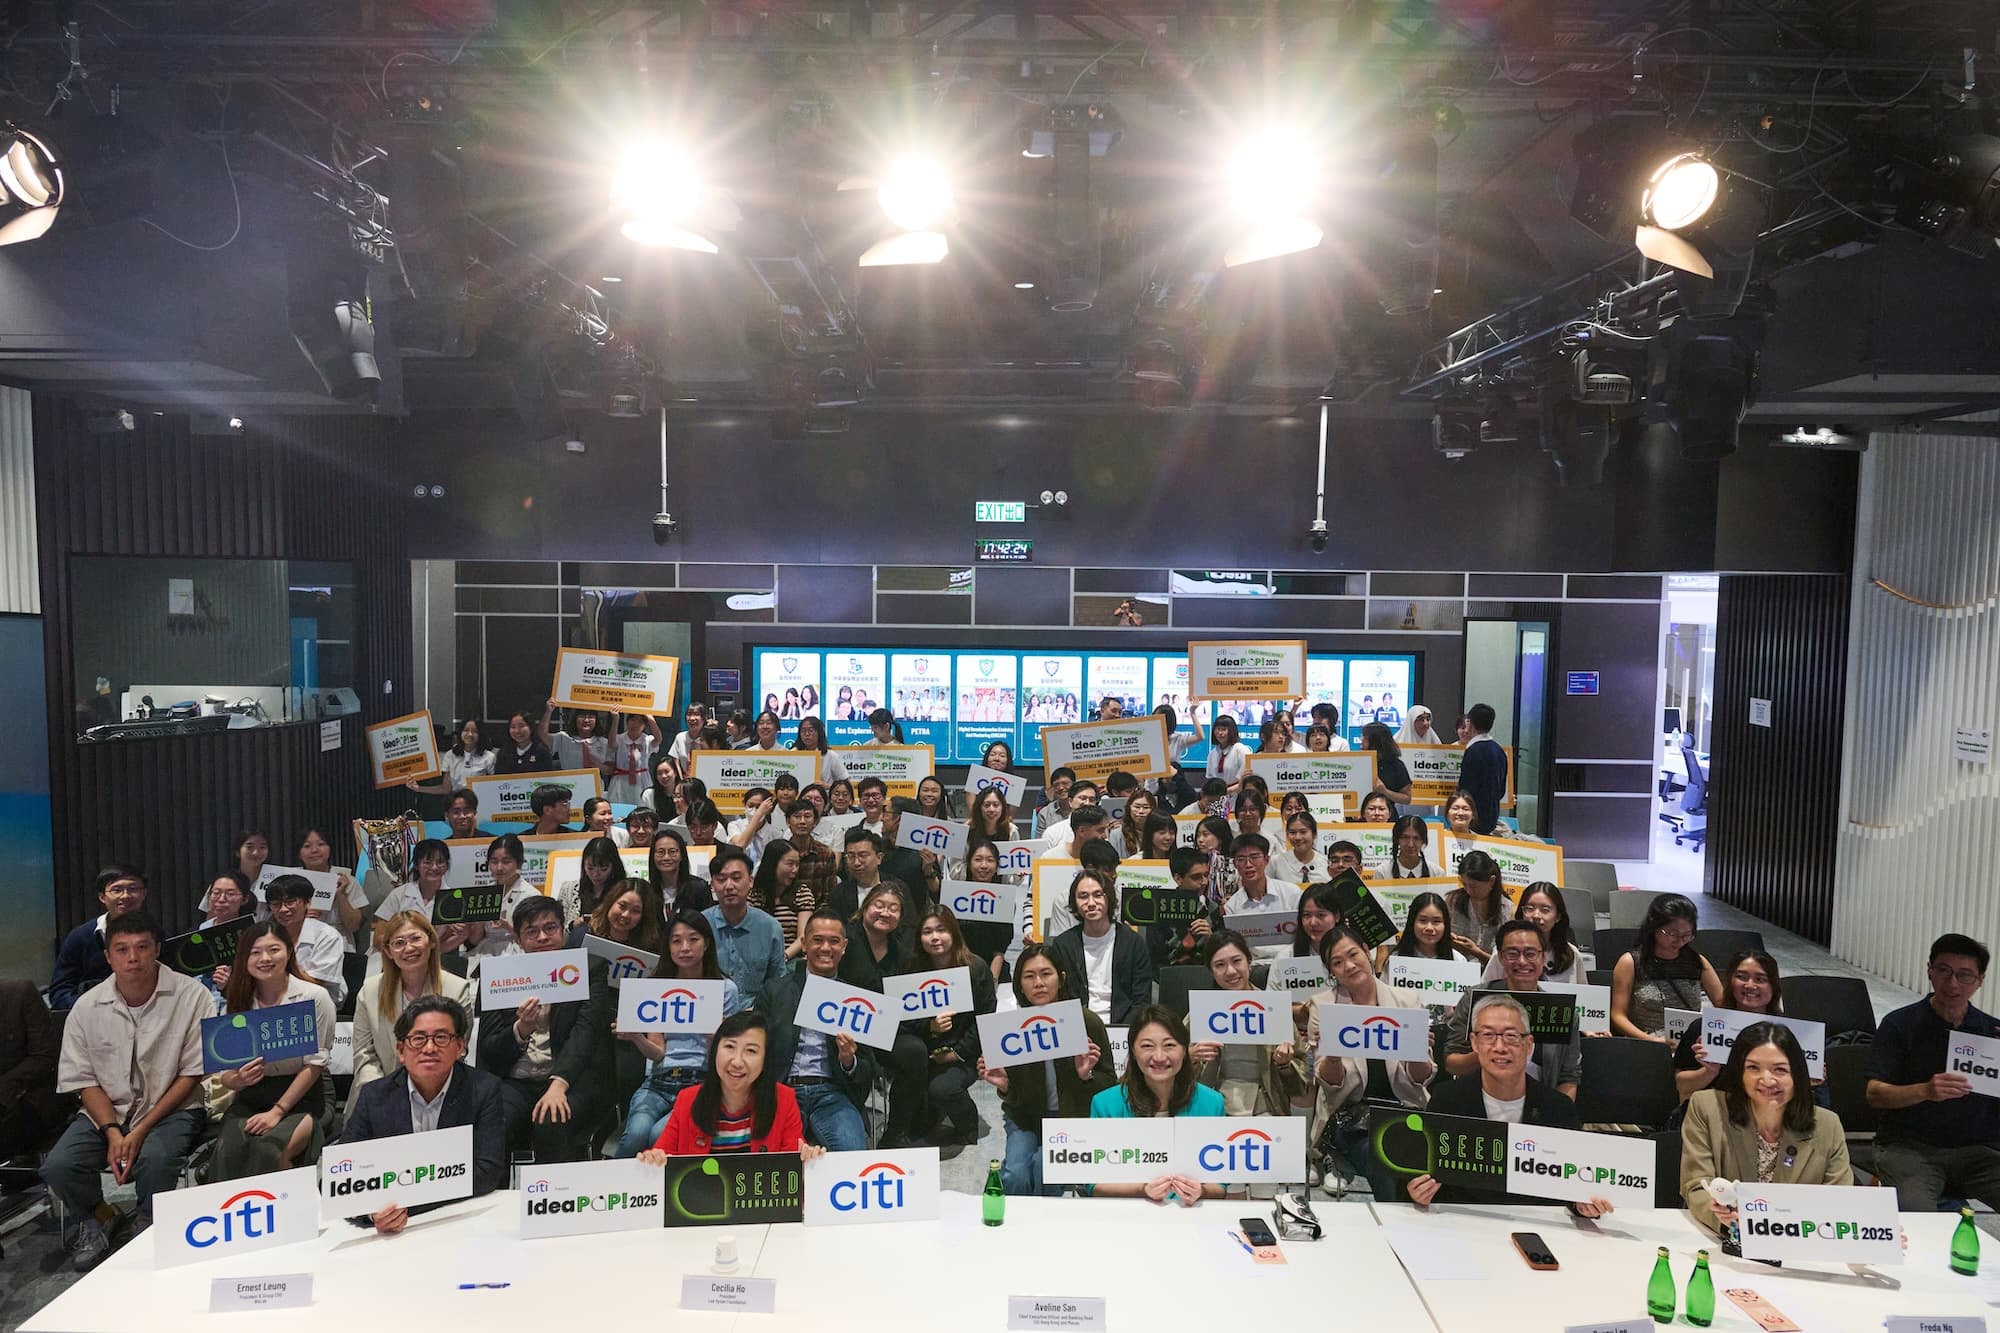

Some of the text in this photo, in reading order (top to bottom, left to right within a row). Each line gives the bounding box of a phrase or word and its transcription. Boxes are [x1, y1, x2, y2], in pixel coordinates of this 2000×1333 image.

[977, 503, 1023, 520] EXIT 出口
[984, 543, 1028, 554] 17:42:24
[1123, 736, 1138, 745] 2025
[722, 768, 774, 778] IdeaPOP!
[1277, 770, 1330, 780] IdeaPOP!
[910, 825, 950, 849] citi
[1323, 832, 1336, 841] citi
[475, 848, 488, 858] cit
[998, 847, 1031, 869] citi
[1512, 864, 1530, 873] 2025
[315, 890, 331, 898] 2025
[468, 894, 501, 908] SEED
[954, 889, 996, 915] citi
[1160, 898, 1196, 912] SEED
[1284, 966, 1298, 975] citi
[1394, 966, 1408, 974] citi
[490, 976, 532, 988] ALIBABA
[1394, 977, 1457, 994] IdeaPOP!
[490, 985, 540, 994] ENTREPRENEURS
[902, 979, 950, 1012] citi
[637, 988, 698, 1024] citi
[817, 997, 876, 1034] citi
[1208, 1000, 1265, 1034] citi
[1587, 1010, 1606, 1018] 2025
[260, 1015, 314, 1040] SEED
[1669, 1020, 1684, 1028] citi
[1708, 1020, 1726, 1030] citi
[1001, 1016, 1060, 1056] citi
[1338, 1016, 1401, 1050] citi
[262, 1035, 314, 1050] FOUNDATION
[1954, 1045, 1974, 1056] citi
[1049, 1132, 1068, 1144] citi
[1199, 1129, 1273, 1172] citi
[1440, 1132, 1504, 1162] SEED
[1515, 1139, 1536, 1152] citi
[1050, 1148, 1168, 1164] IdeaPOP! 2025
[330, 1160, 352, 1174] citi
[1438, 1159, 1504, 1175] FOUNDATION
[1514, 1156, 1648, 1189] IdeaPOP! 2025
[330, 1164, 466, 1198] IdeaPOP! 2025
[527, 1178, 548, 1193] citi
[735, 1172, 800, 1196] SEED
[830, 1162, 905, 1212] citi
[527, 1192, 658, 1216] IdeaPOP! 2025
[735, 1198, 799, 1208] FOUNDATION
[1746, 1198, 1768, 1212] citi
[185, 1190, 277, 1248] citi
[1747, 1218, 1893, 1241] IdeaPOP! 2025
[237, 1282, 286, 1292] Ernest Leung
[712, 1283, 746, 1294] Cecilia Ho
[1034, 1303, 1076, 1312] Aveline San
[1920, 1322, 1953, 1333] Freda Ng
